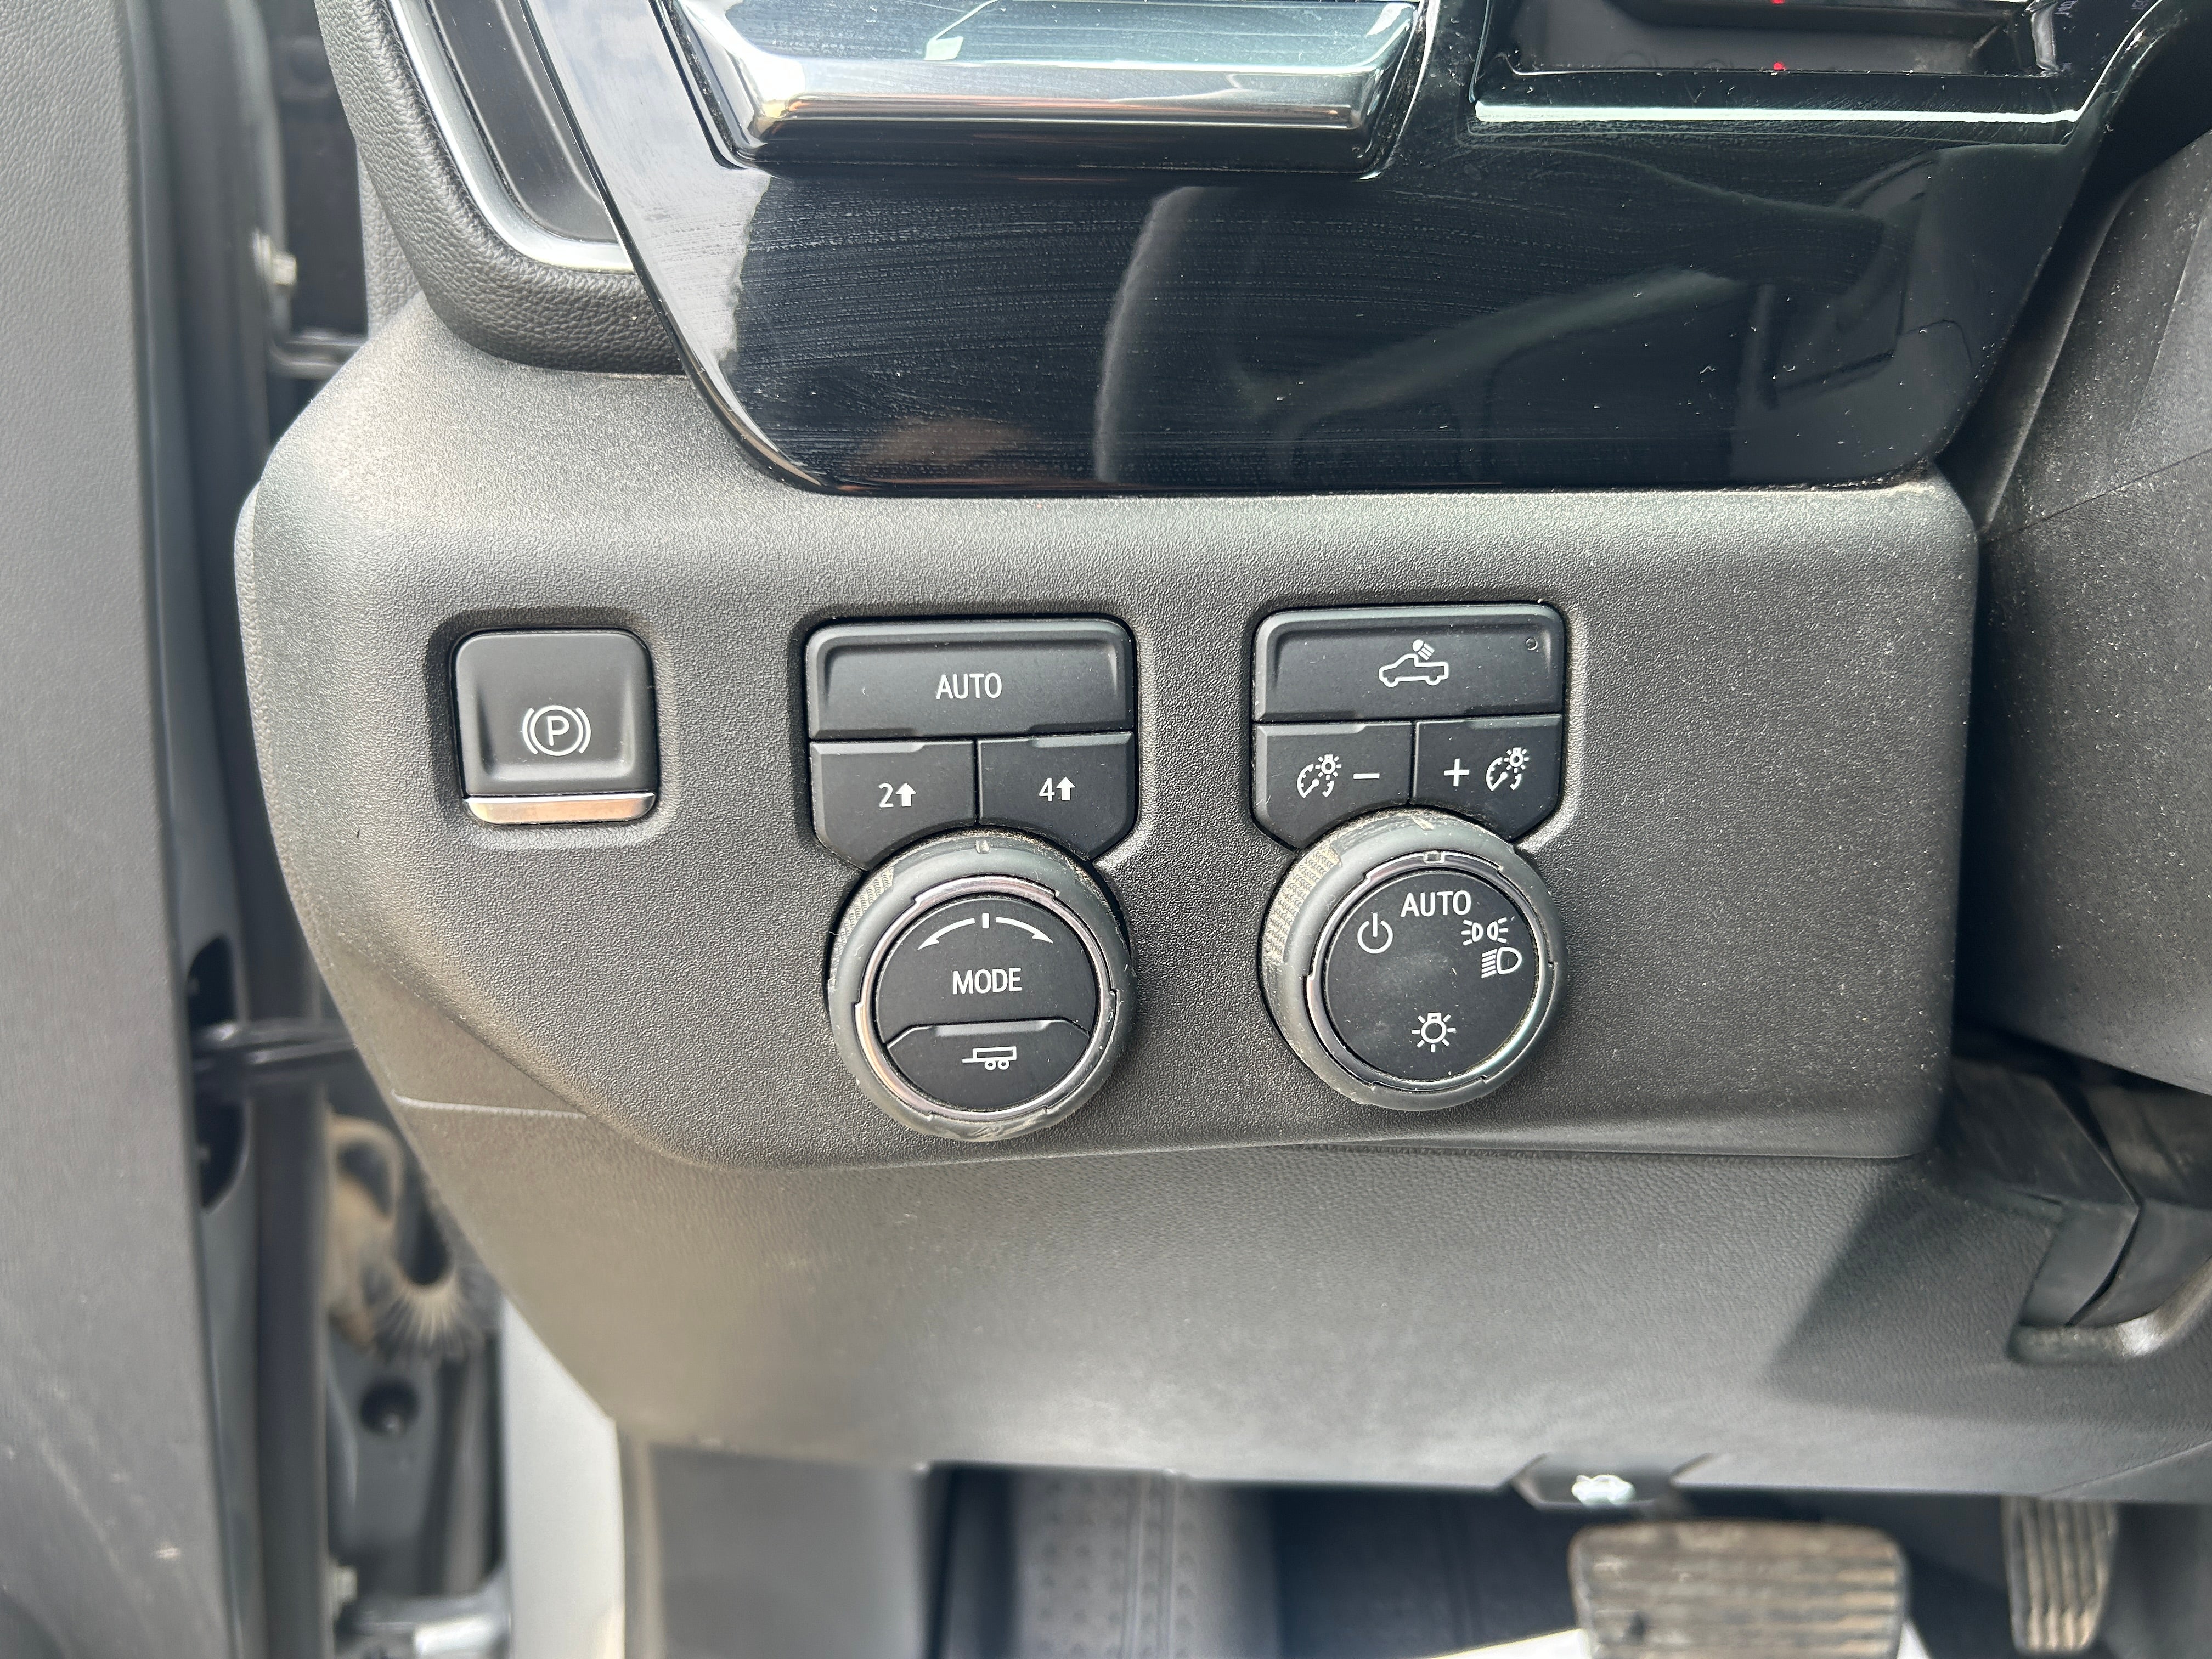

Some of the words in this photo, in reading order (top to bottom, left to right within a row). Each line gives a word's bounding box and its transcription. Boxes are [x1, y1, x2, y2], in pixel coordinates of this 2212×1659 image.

[936, 674, 1002, 699] AUTO
[546, 714, 569, 746] P
[877, 782, 894, 808] 2
[1039, 777, 1056, 802] 4
[1400, 890, 1472, 918] AUTO
[950, 967, 1023, 995] MODE
